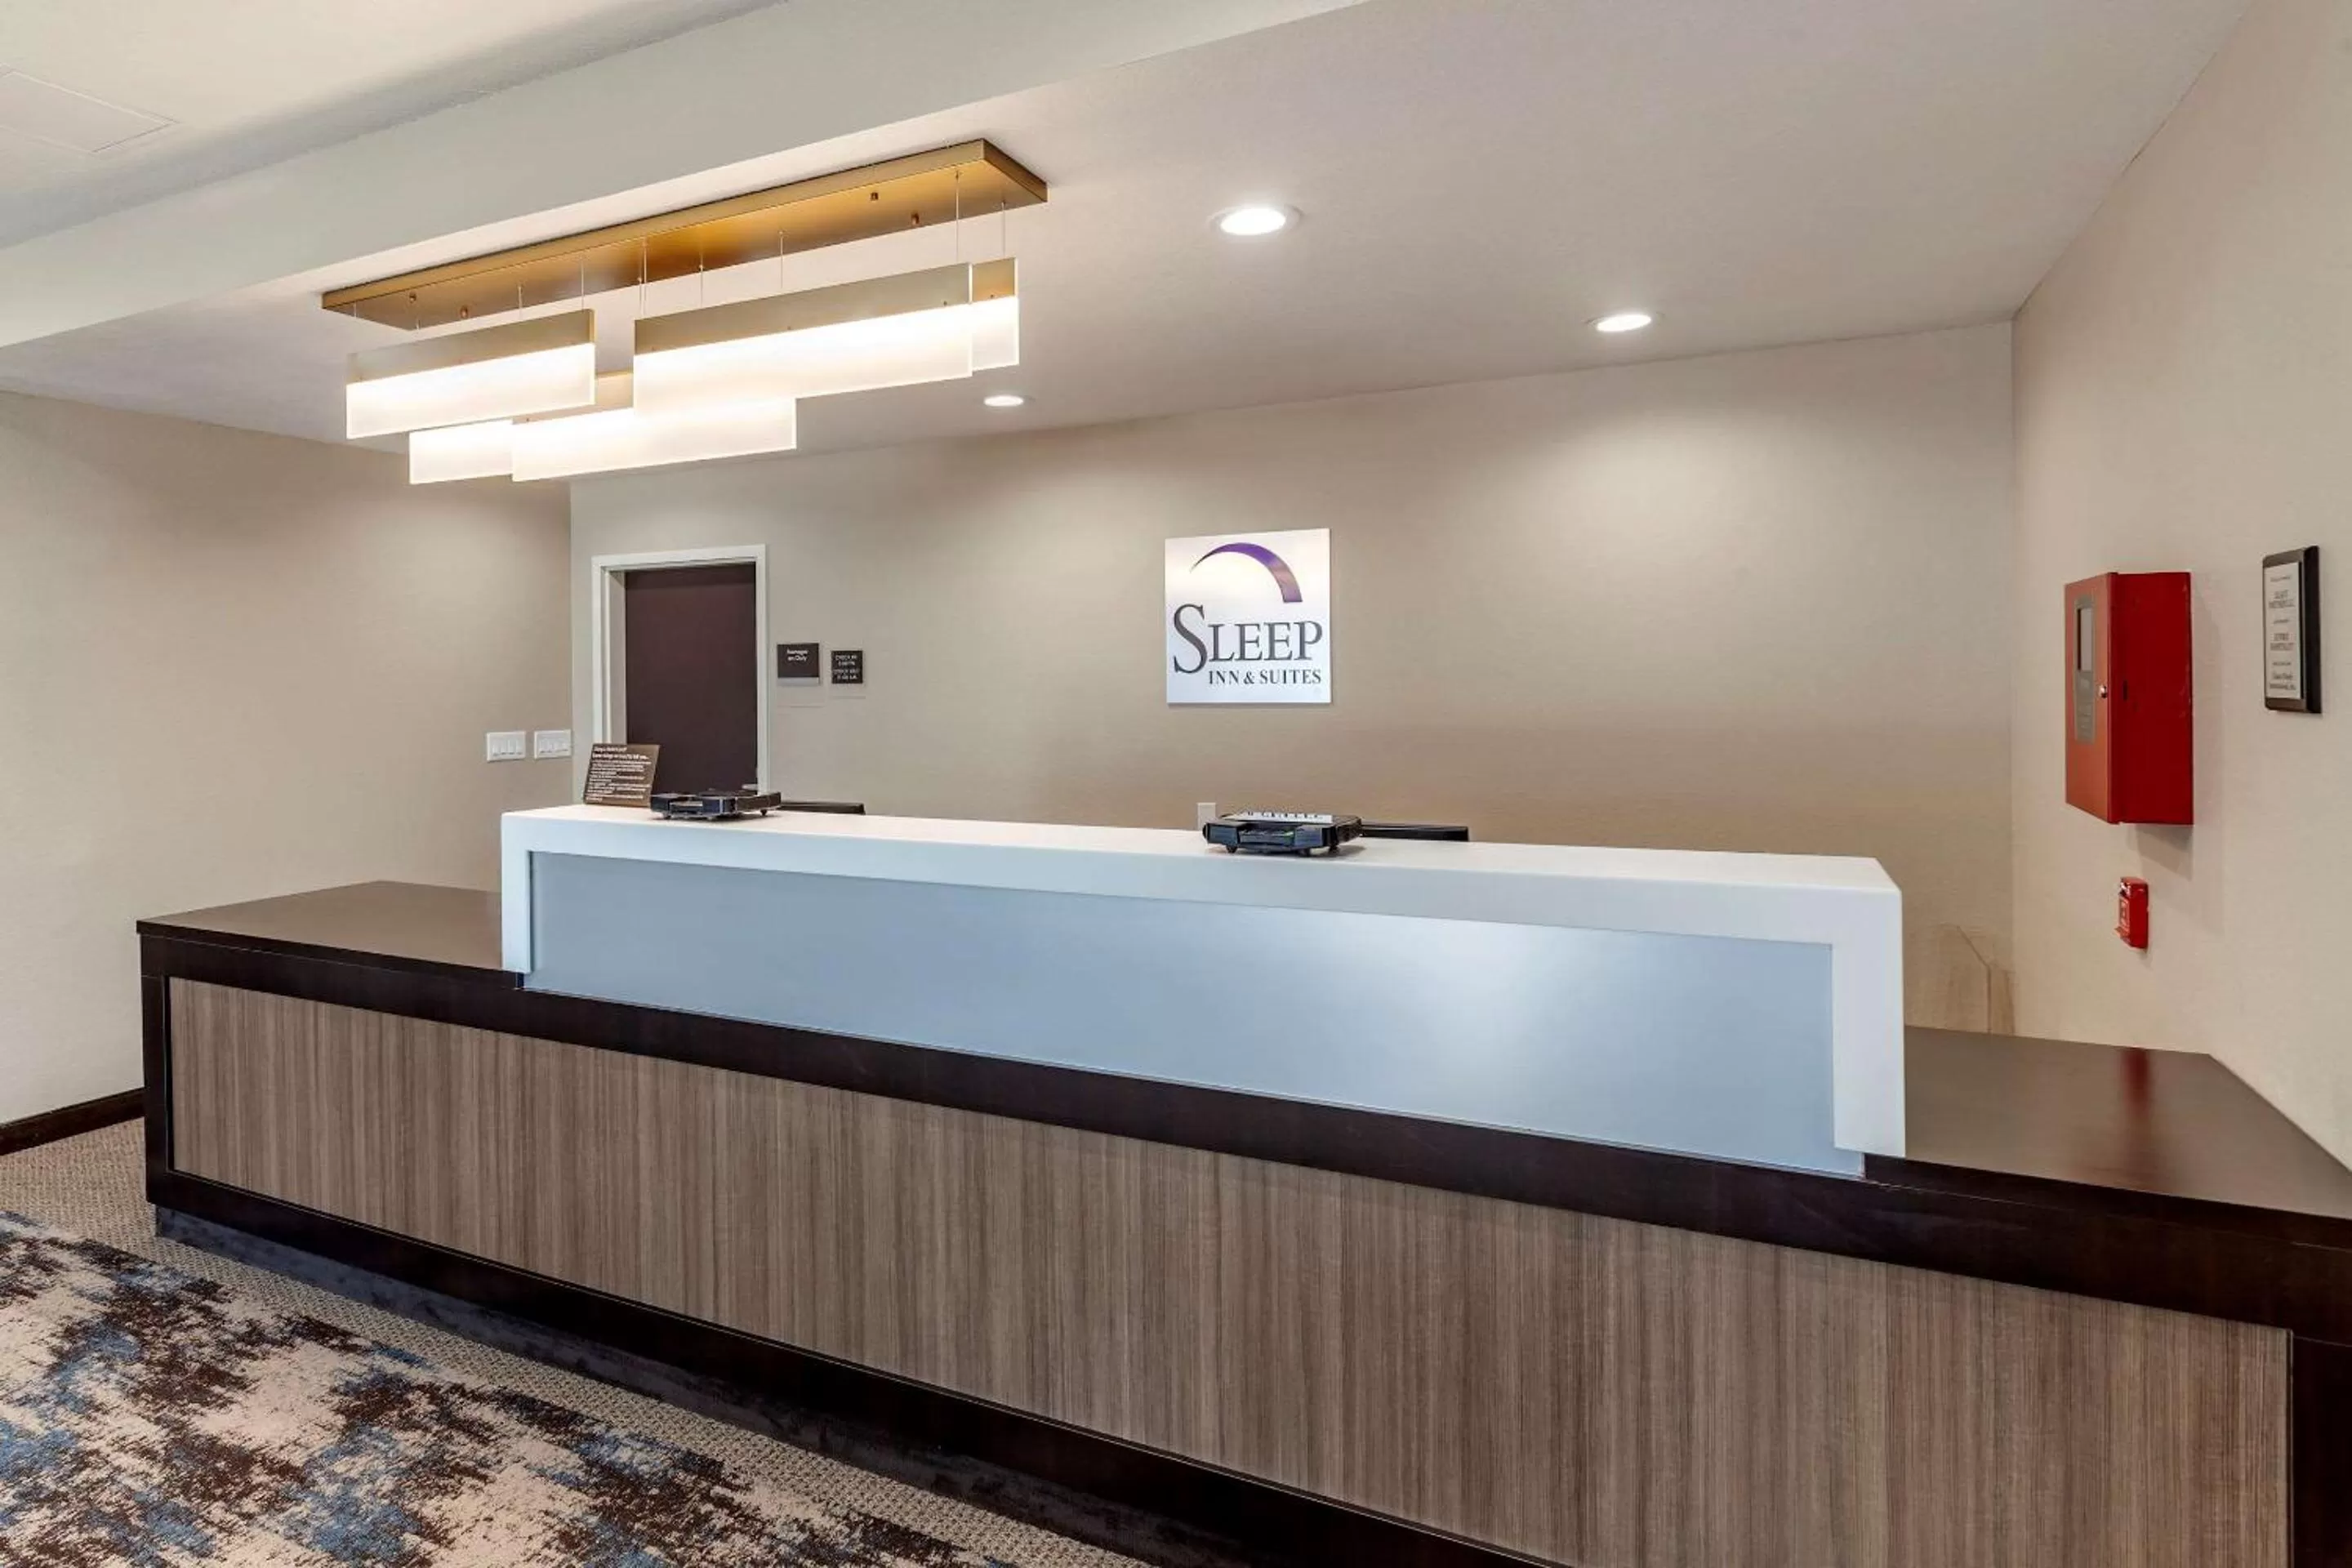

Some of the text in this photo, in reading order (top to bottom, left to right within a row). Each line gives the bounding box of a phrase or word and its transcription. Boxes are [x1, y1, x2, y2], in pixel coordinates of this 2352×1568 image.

[1174, 604, 1323, 674] SLEEP
[1209, 669, 1321, 684] INN & SUITES
